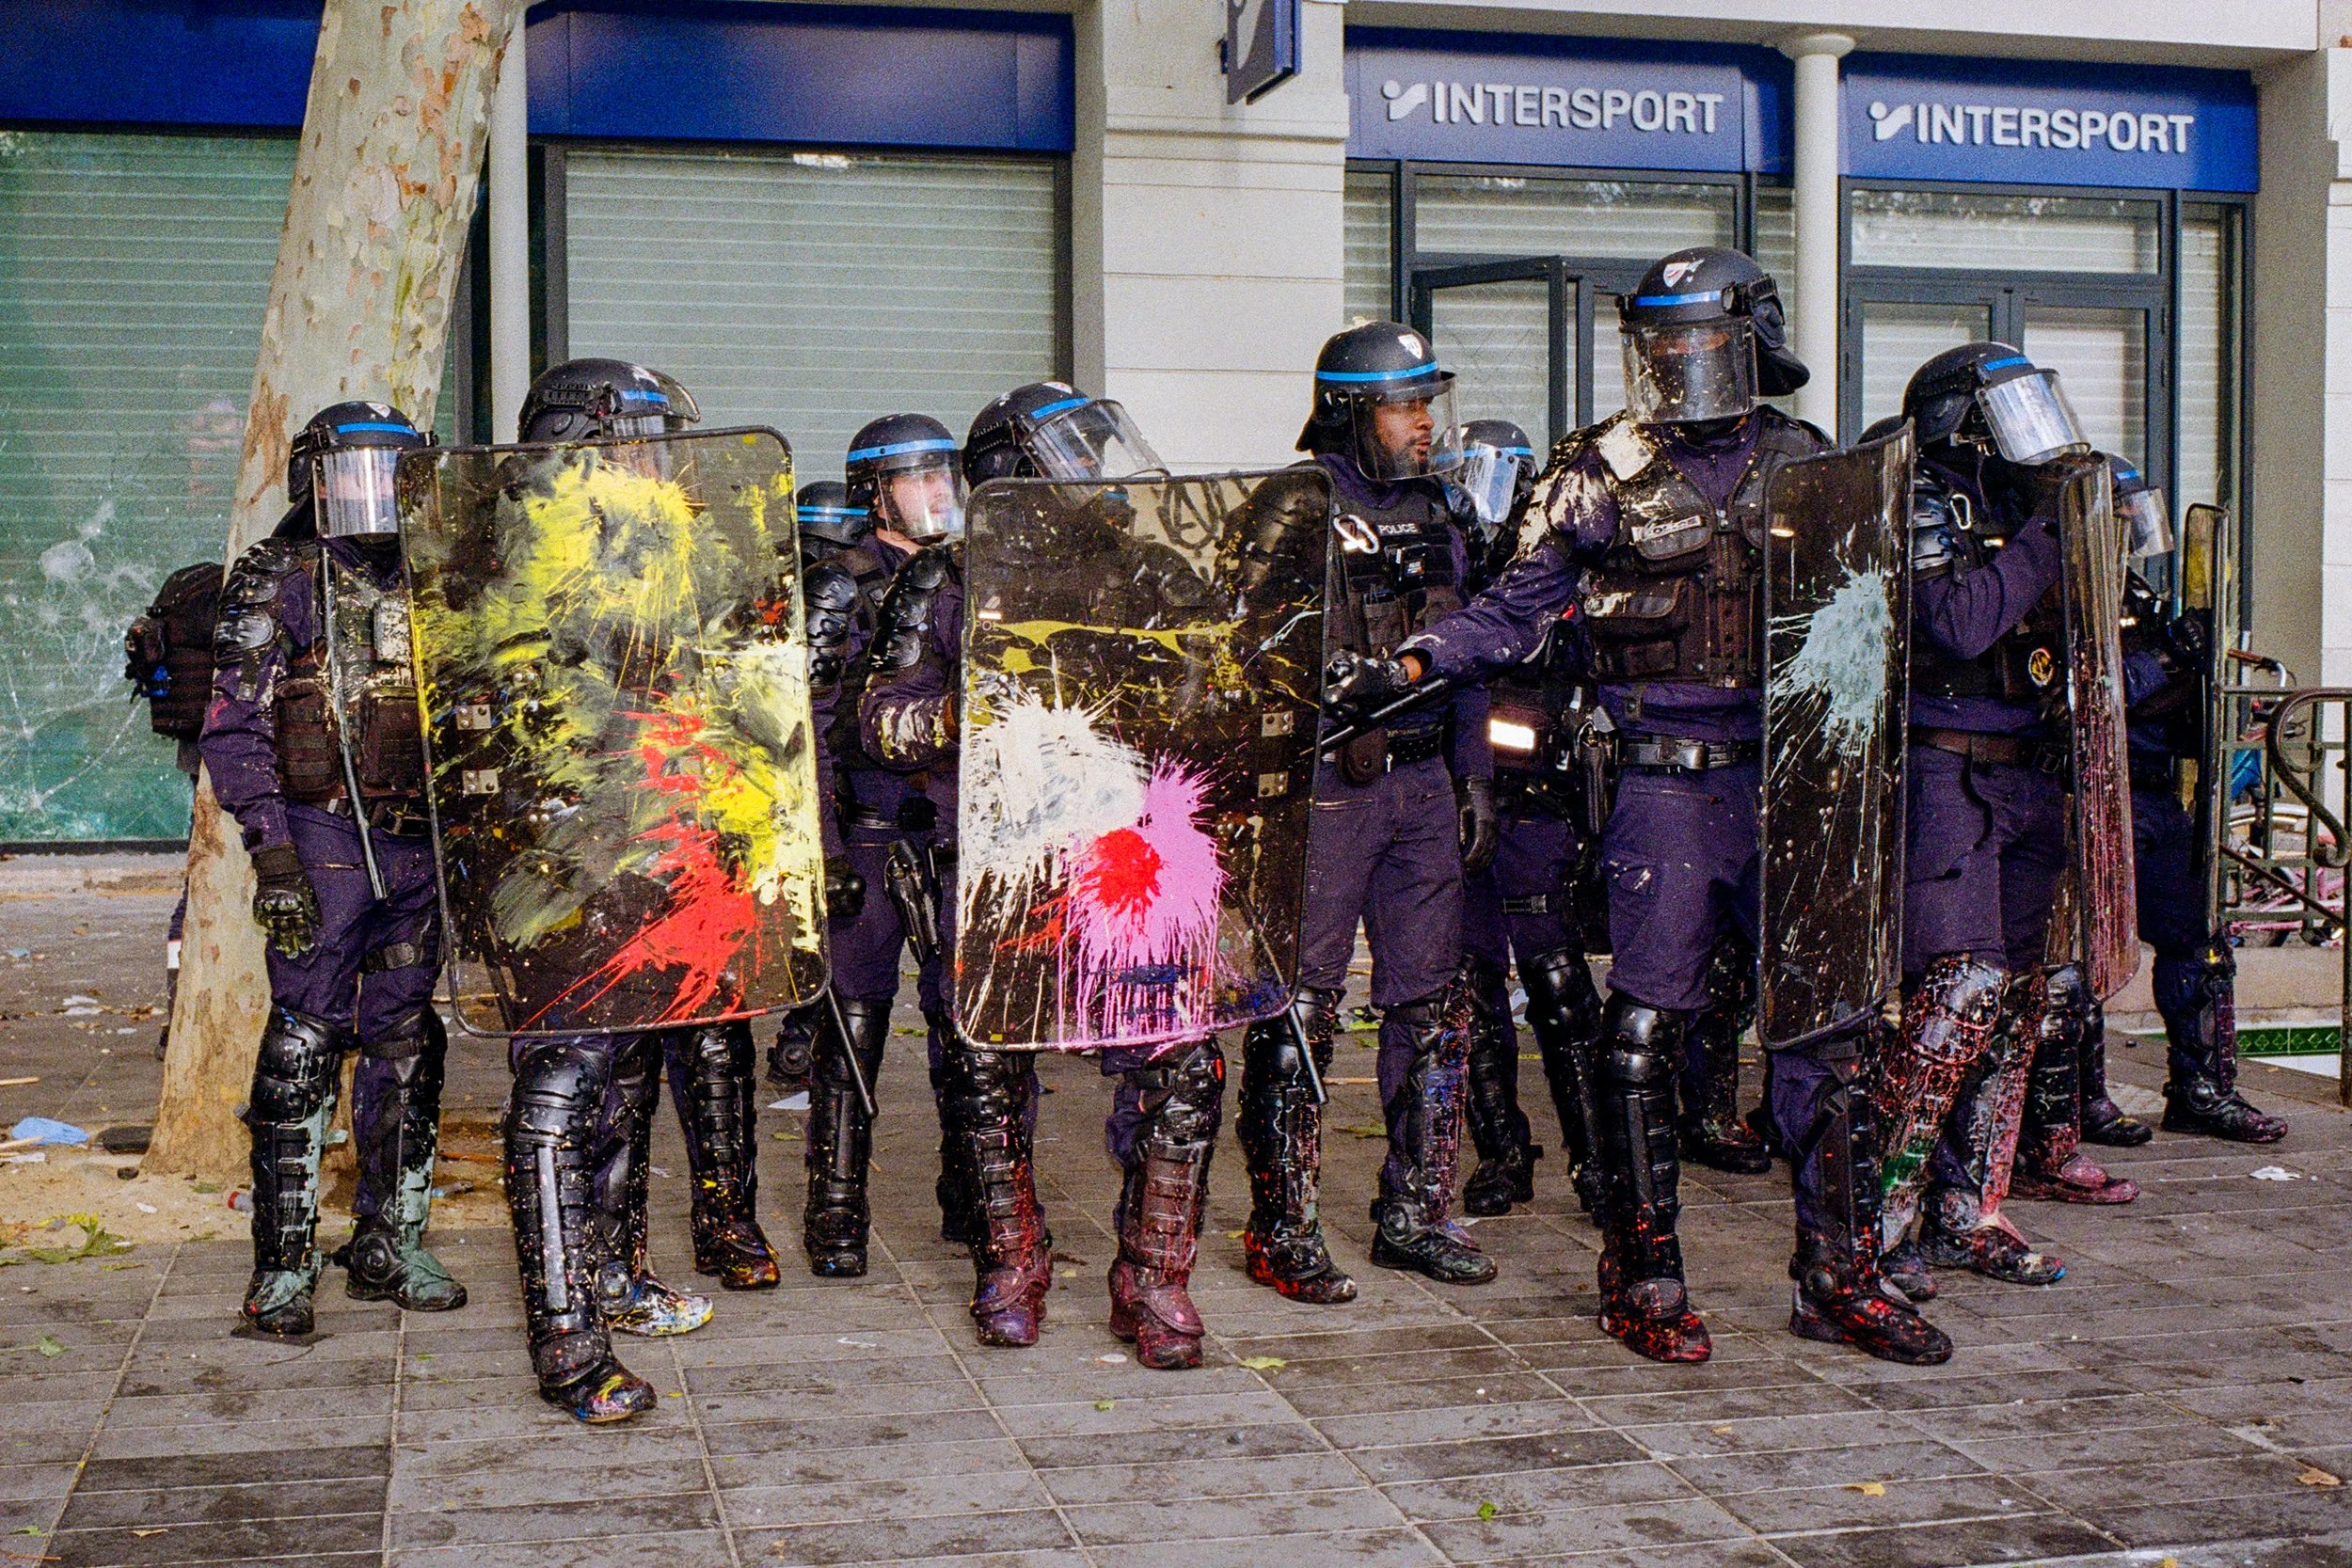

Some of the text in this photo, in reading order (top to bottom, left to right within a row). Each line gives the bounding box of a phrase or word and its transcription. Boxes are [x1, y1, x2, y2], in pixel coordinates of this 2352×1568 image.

[1433, 81, 1724, 134] INTERSPORT
[1915, 103, 2195, 153] INTERSPORT
[1378, 523, 1418, 535] POLICE
